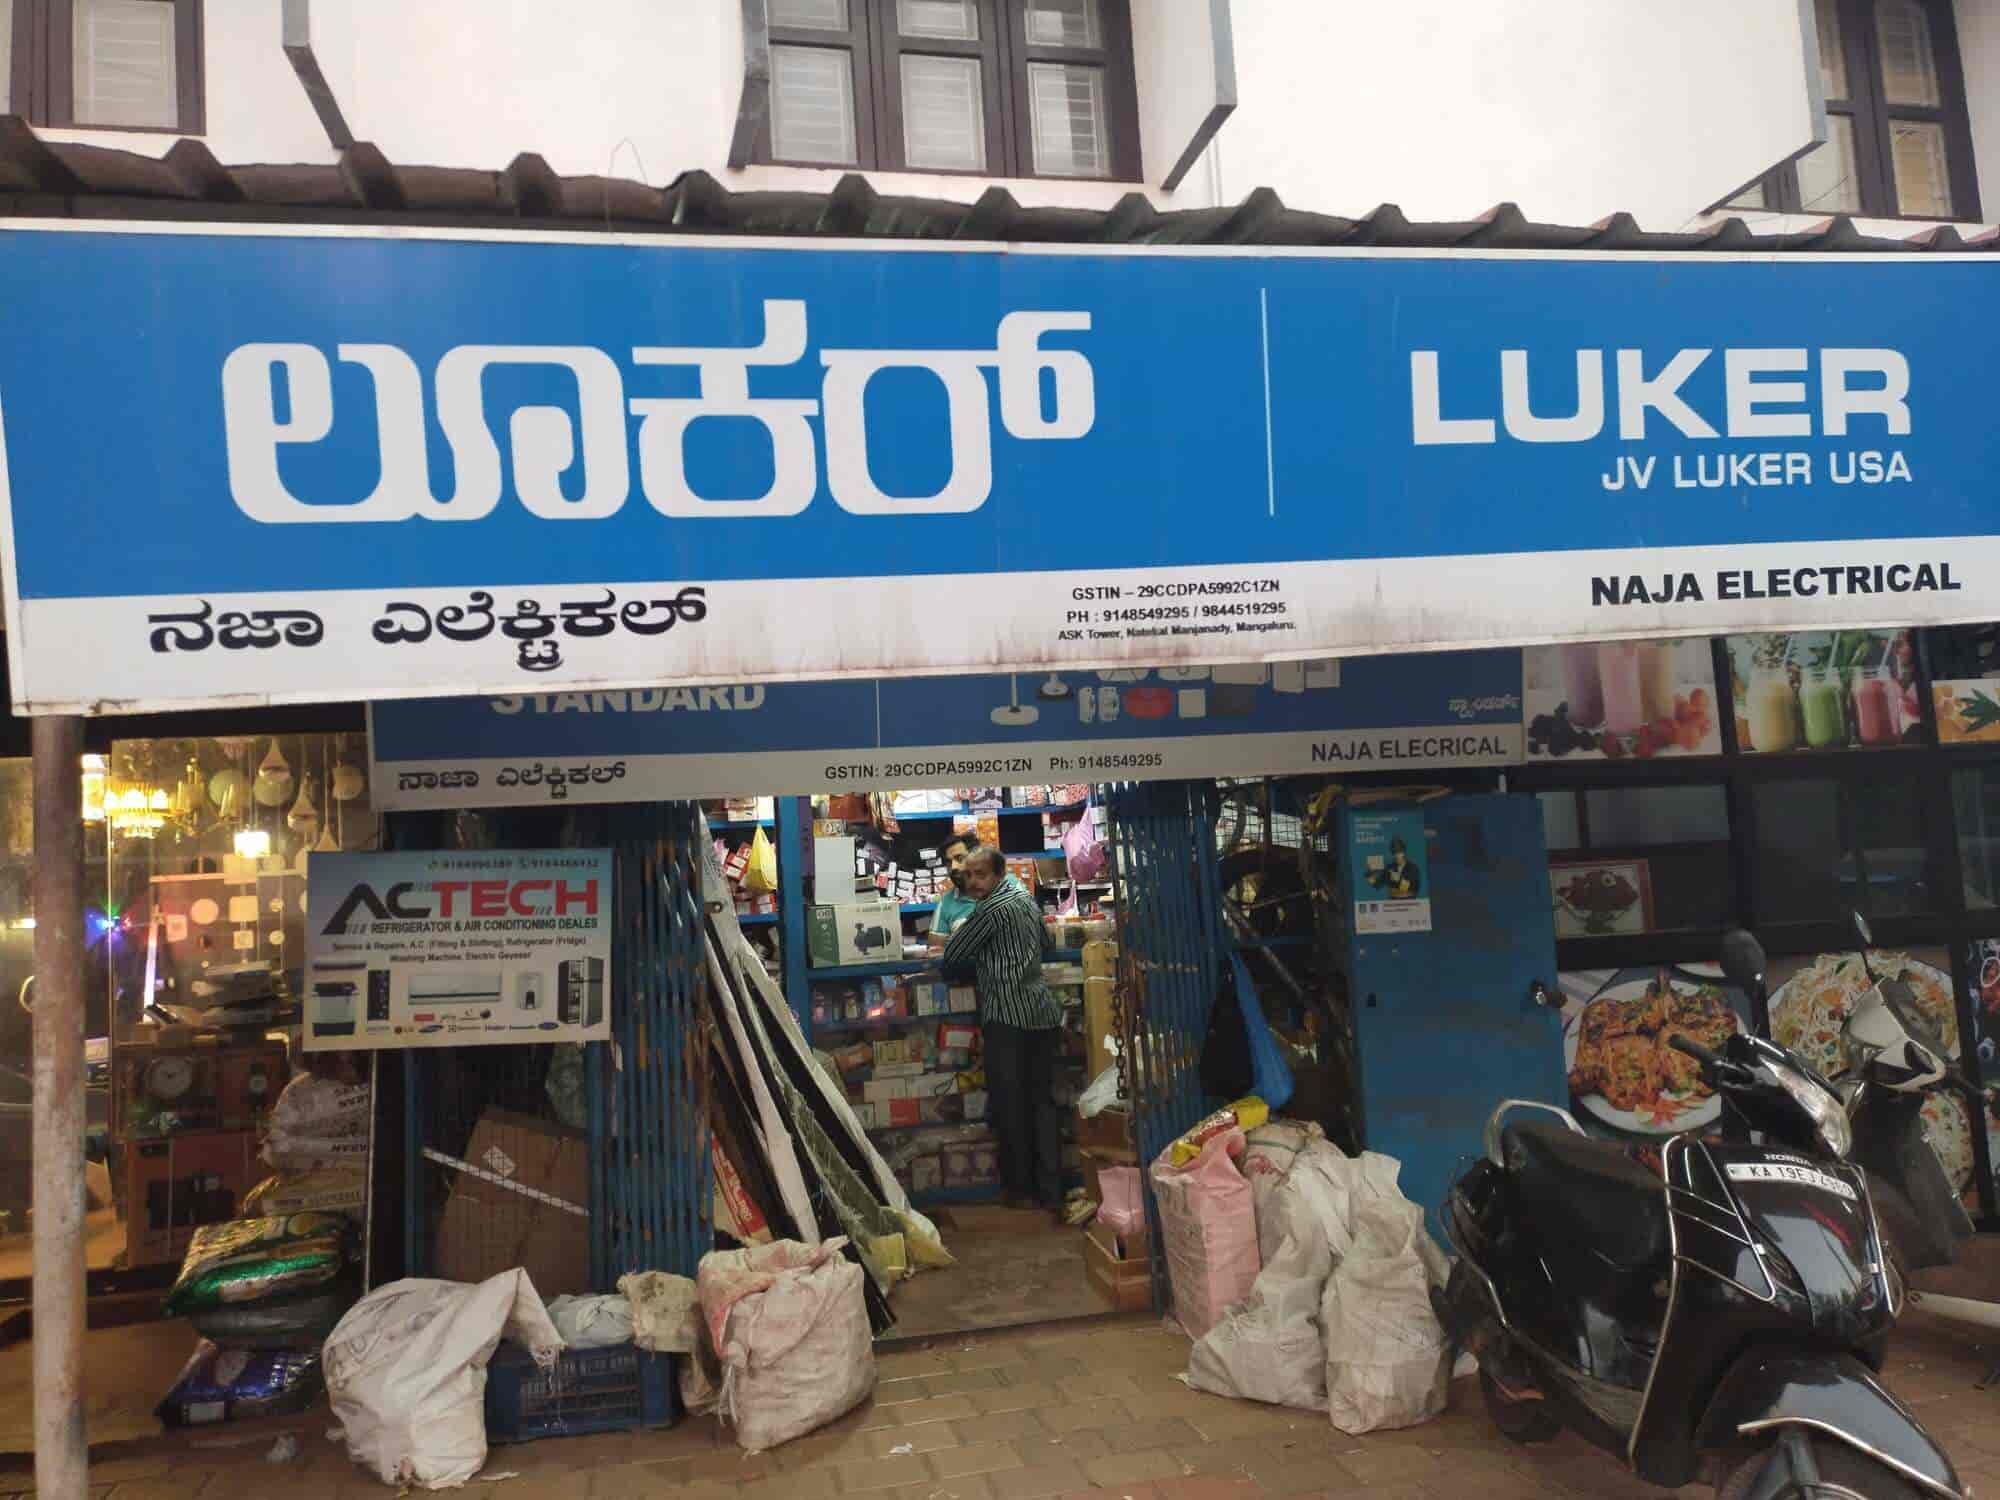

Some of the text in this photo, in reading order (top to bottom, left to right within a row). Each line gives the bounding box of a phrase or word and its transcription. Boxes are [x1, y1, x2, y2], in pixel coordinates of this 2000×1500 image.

[1411, 348, 1912, 446] LUKER
[222, 300, 1096, 524] ಲೂಕರ್
[1601, 450, 1913, 491] JV LUKER USA
[1072, 586, 1121, 601] GSTIN
[1136, 580, 1281, 598] 29CCDPA5992C1ZN
[1591, 562, 1962, 607] NAJA ELECTRICAL
[1066, 610, 1089, 623] PH
[1103, 607, 1190, 622] 9148549295
[1201, 601, 1287, 617] 9844519295
[148, 587, 707, 671] ನಜಾ ಎಲೆಕ್ಟ್ರಿಕಲ್
[1058, 629, 1083, 641] ASK
[1311, 735, 1507, 762] NAJA ELECRICAL
[825, 757, 1033, 780] GSTIN: 29CCDPA5992C1ZN
[1050, 753, 1163, 771] Ph: 9148549295
[370, 921, 452, 934] REFRIGERATOR
[464, 920, 482, 931] AIR
[484, 918, 557, 931] CONDITIONING
[559, 917, 598, 929] DEALES
[1763, 1153, 1814, 1167] HONDA
